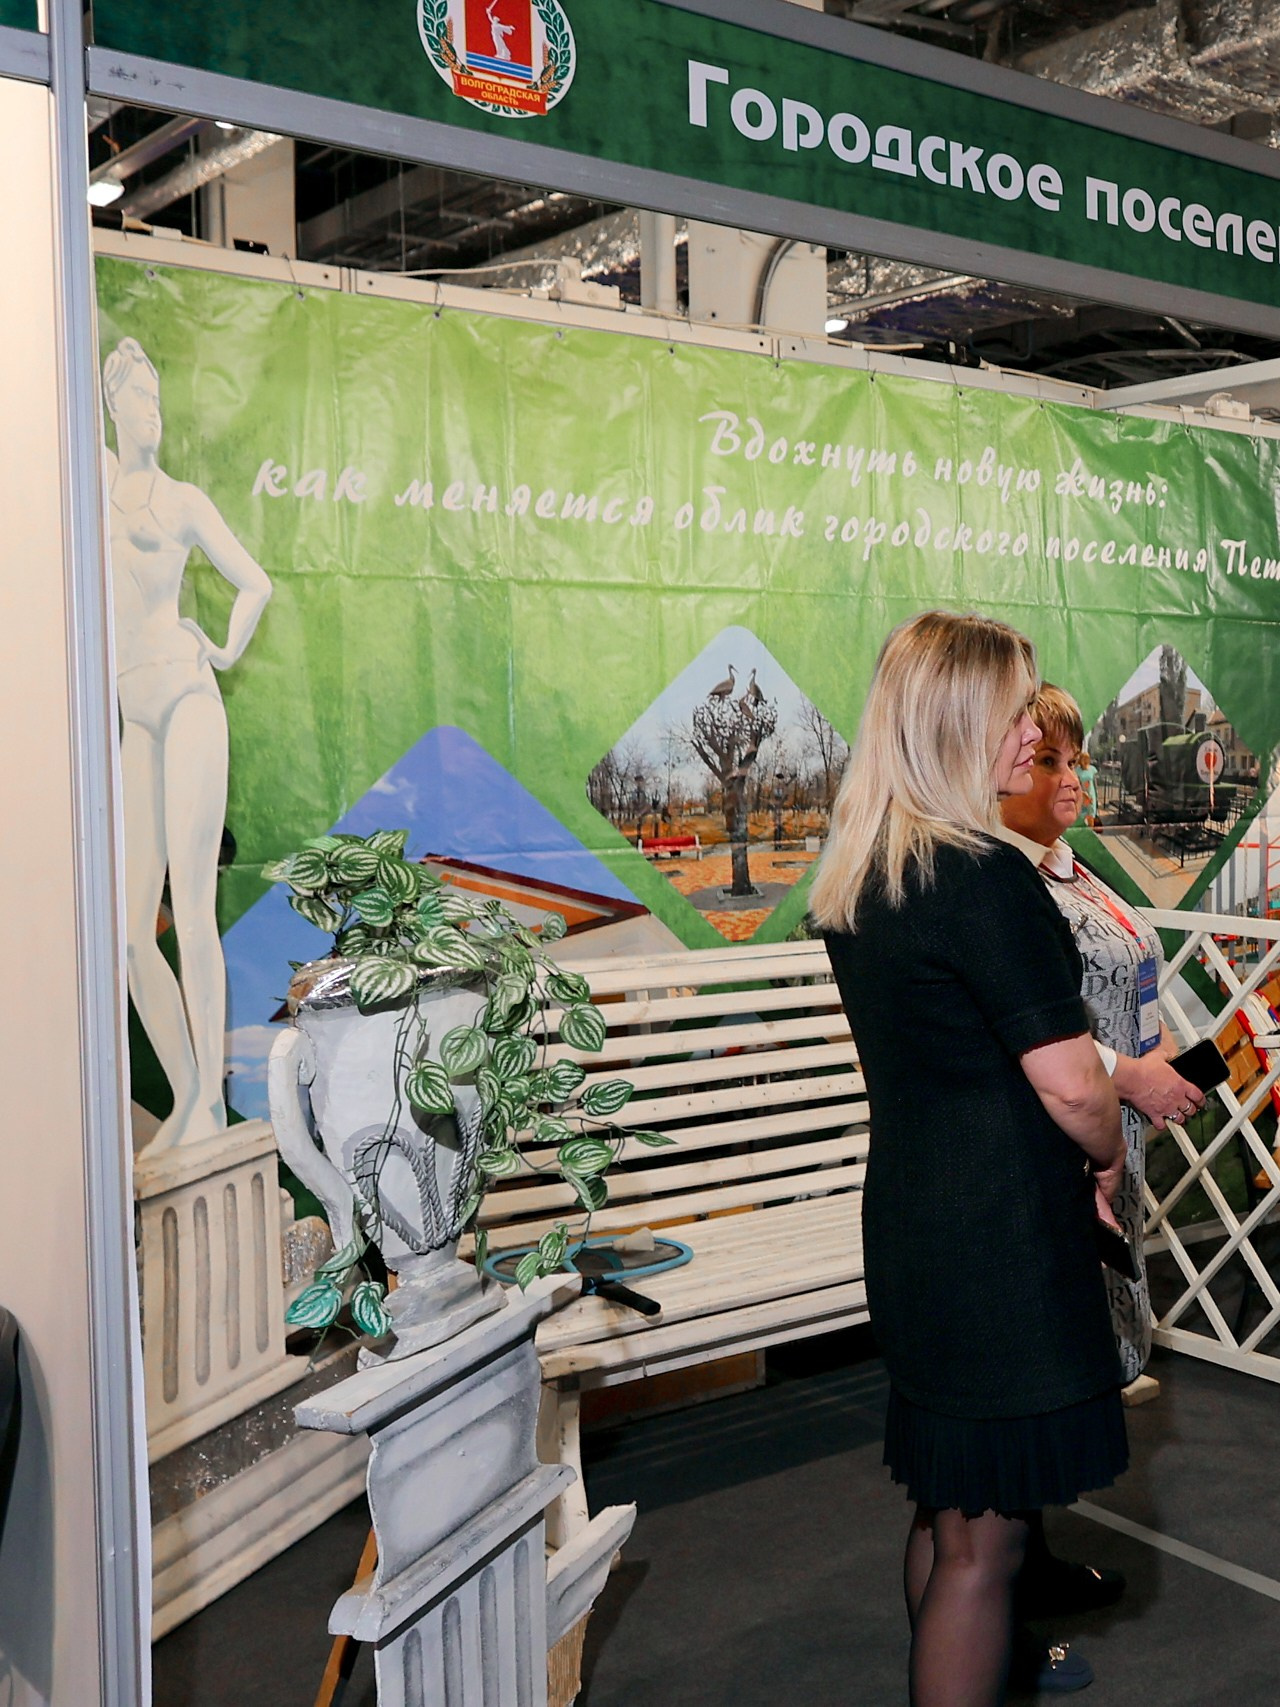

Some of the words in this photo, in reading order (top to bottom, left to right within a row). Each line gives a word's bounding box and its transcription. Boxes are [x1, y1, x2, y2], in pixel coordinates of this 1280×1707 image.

[460, 77, 541, 102] ВОЛГОГРАДСКАЯ
[480, 91, 519, 106] ОБЛАСТЬ
[688, 59, 1064, 212] Городское
[698, 409, 917, 480] Вдохнуть
[934, 446, 1040, 503] новую
[1055, 457, 1169, 514] жизнь:
[252, 457, 369, 504] как
[394, 478, 655, 526] меняется
[674, 486, 805, 537] облик
[824, 507, 1029, 562] городского
[1045, 532, 1208, 573] поселения
